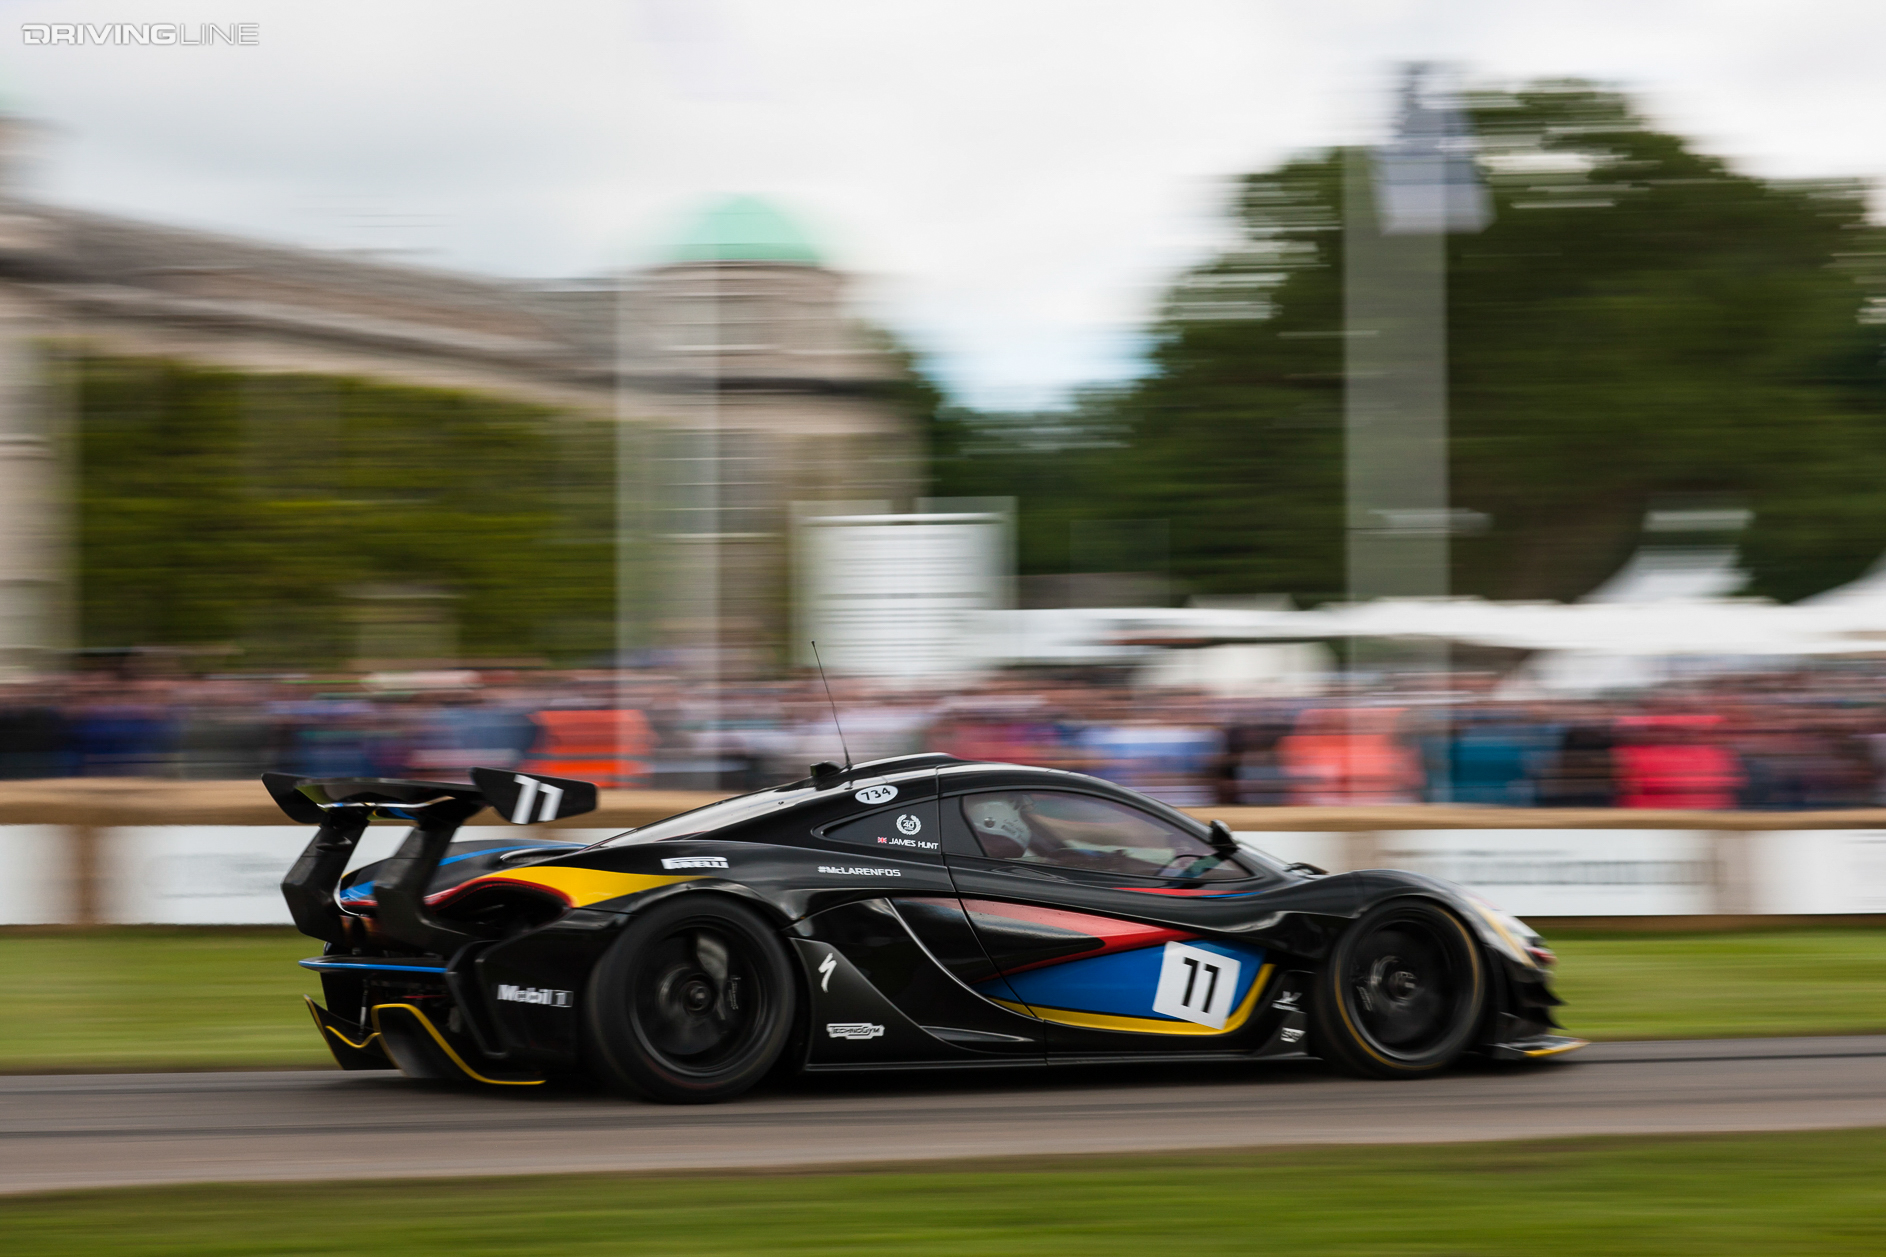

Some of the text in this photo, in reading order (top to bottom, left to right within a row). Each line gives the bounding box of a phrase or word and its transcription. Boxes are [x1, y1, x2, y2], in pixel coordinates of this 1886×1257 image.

[511, 774, 564, 825] 11
[861, 787, 891, 800] 734
[888, 838, 939, 849] JAMES HUNT
[817, 865, 902, 877] #McLARENFOS
[1181, 956, 1221, 1014] 11
[497, 984, 552, 1005] Mobil
